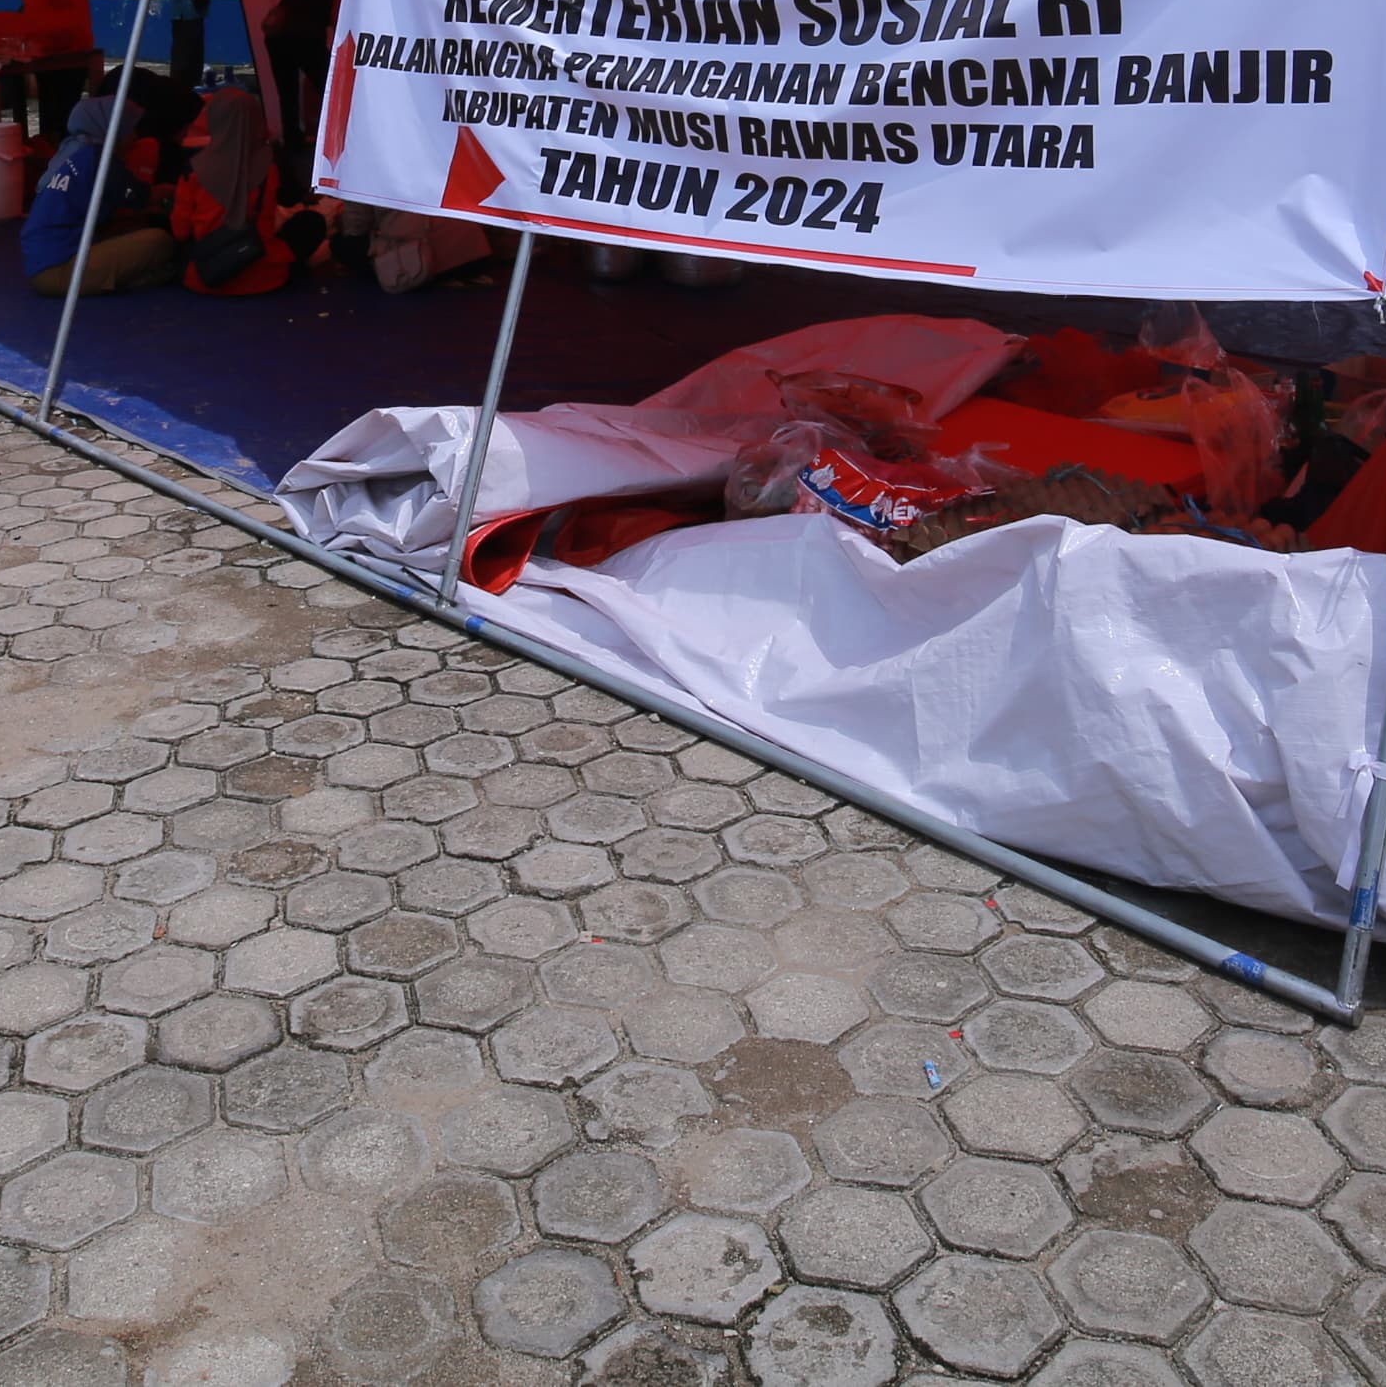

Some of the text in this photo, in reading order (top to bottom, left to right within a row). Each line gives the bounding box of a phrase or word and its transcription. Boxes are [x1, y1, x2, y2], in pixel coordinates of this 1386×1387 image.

[441, 39, 558, 80] RANGKA
[563, 52, 845, 106] PENANGANAN
[849, 58, 1099, 106] BENCANA
[1115, 50, 1332, 104] BANJIR
[442, 88, 1094, 168] KABUPATEN MUSI RAWAS UTARA
[541, 148, 884, 233] TAHUN 2024
